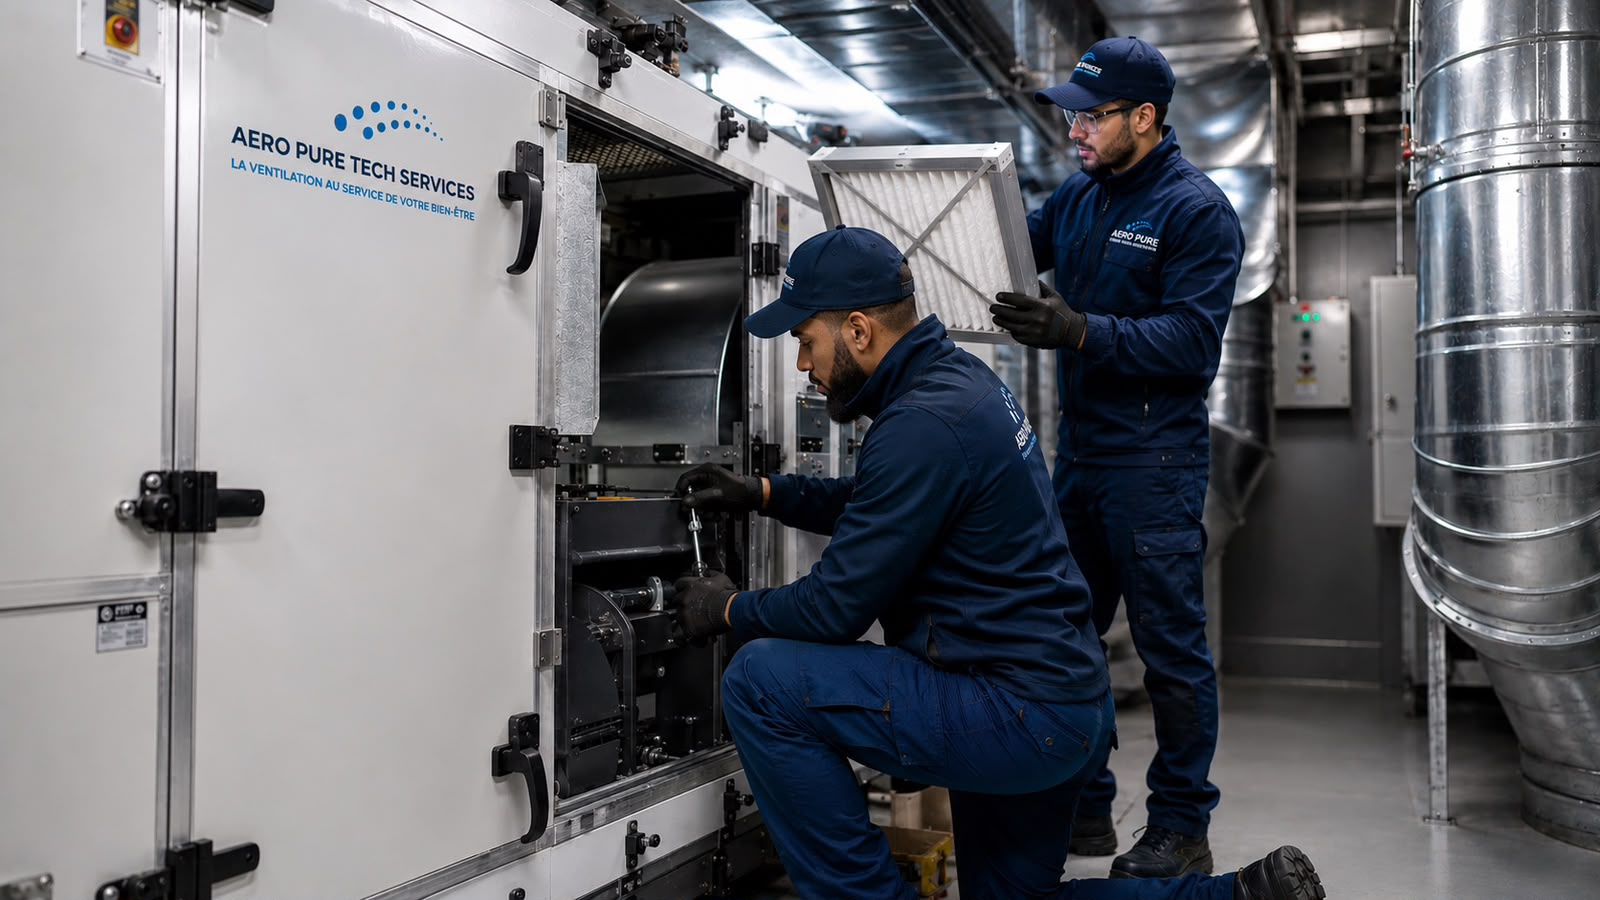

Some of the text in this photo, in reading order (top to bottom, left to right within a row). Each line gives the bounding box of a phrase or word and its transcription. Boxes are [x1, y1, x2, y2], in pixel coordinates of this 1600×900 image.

[231, 126, 475, 201] AERO PURE TECH SERVICES
[231, 158, 475, 221] LA VENTILATION AU SERVICE DE VOTRE BIEN-ÊTRE
[1111, 230, 1134, 240] AERO
[1134, 234, 1160, 247] PURE
